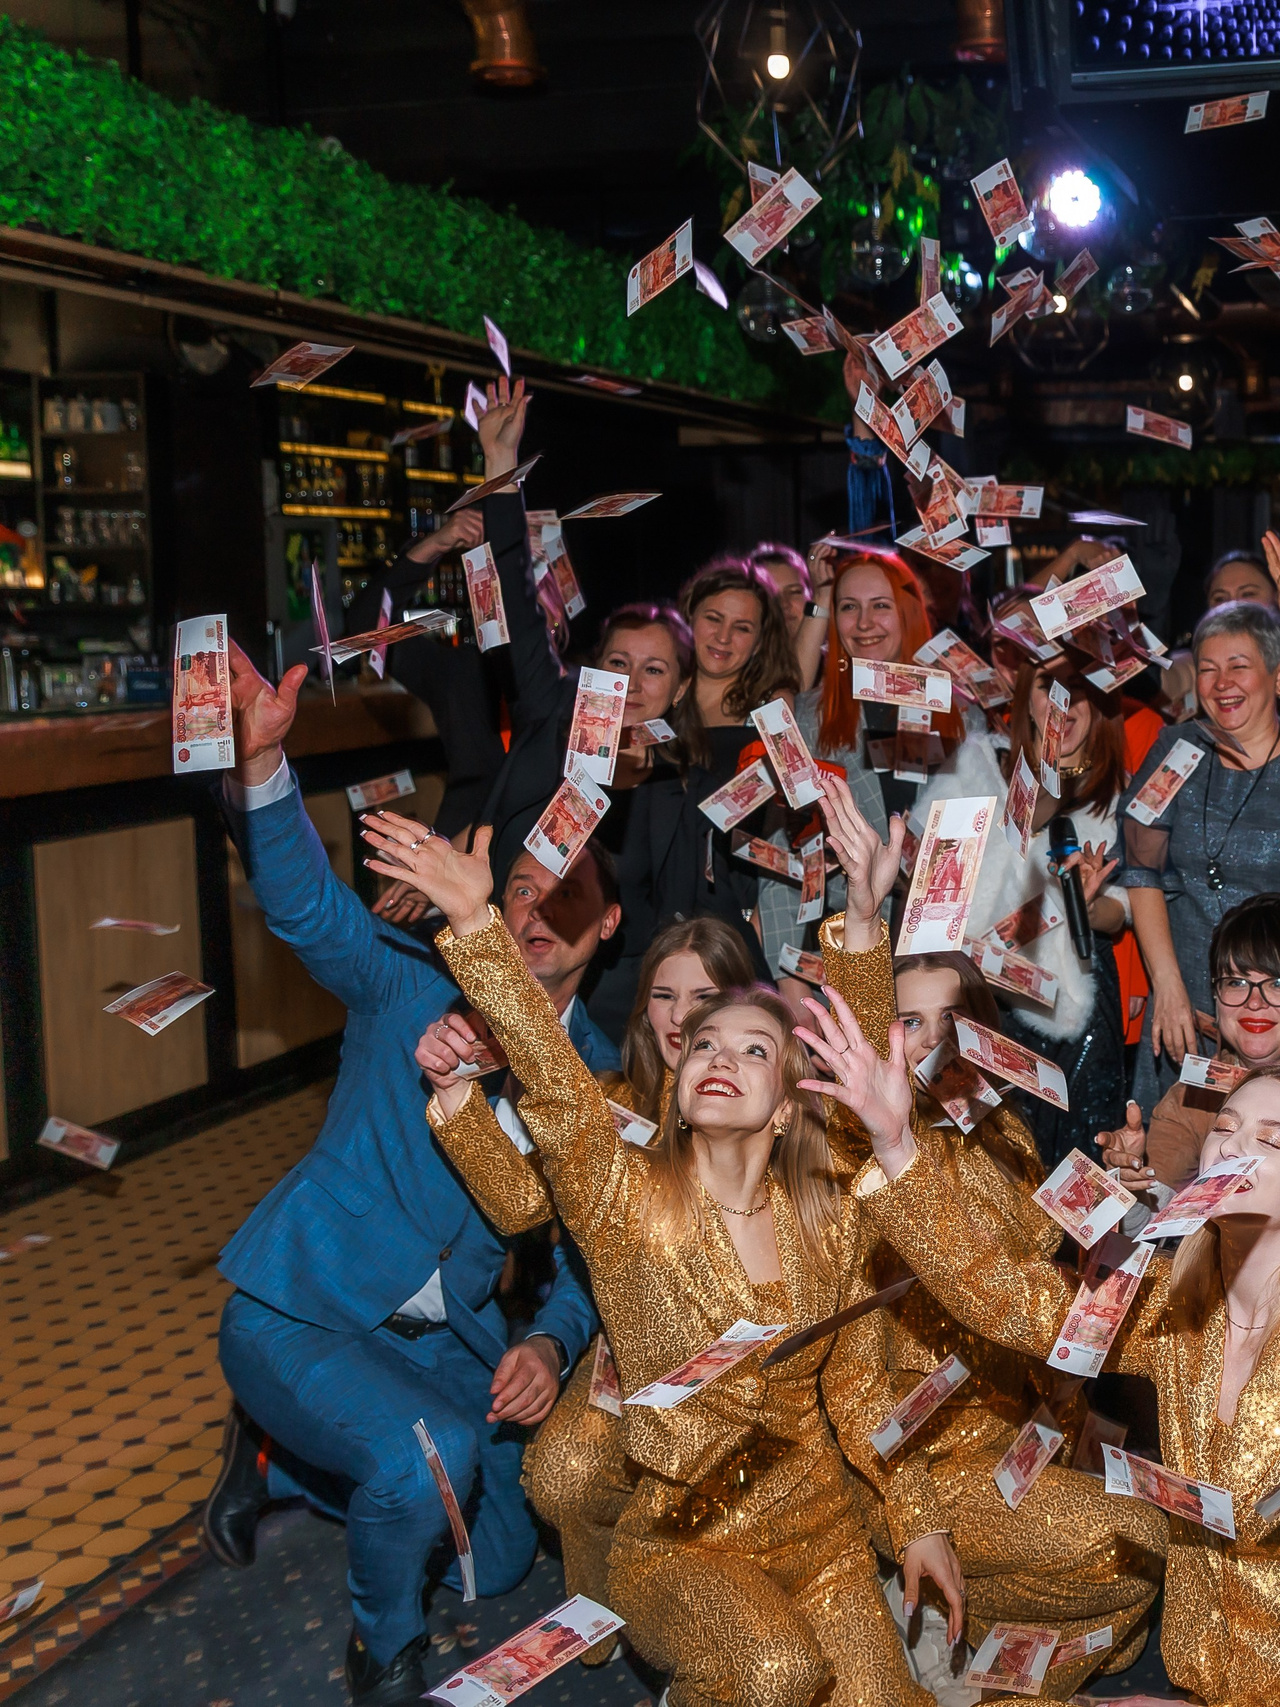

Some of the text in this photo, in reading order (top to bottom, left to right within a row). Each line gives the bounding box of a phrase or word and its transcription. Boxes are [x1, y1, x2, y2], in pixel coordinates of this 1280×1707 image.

[1106, 590, 1130, 608] 5000
[175, 711, 186, 742] 5000
[973, 808, 988, 833] 5000
[905, 896, 925, 934] 5000
[947, 918, 961, 941] 5000
[1064, 1313, 1082, 1342] 5000
